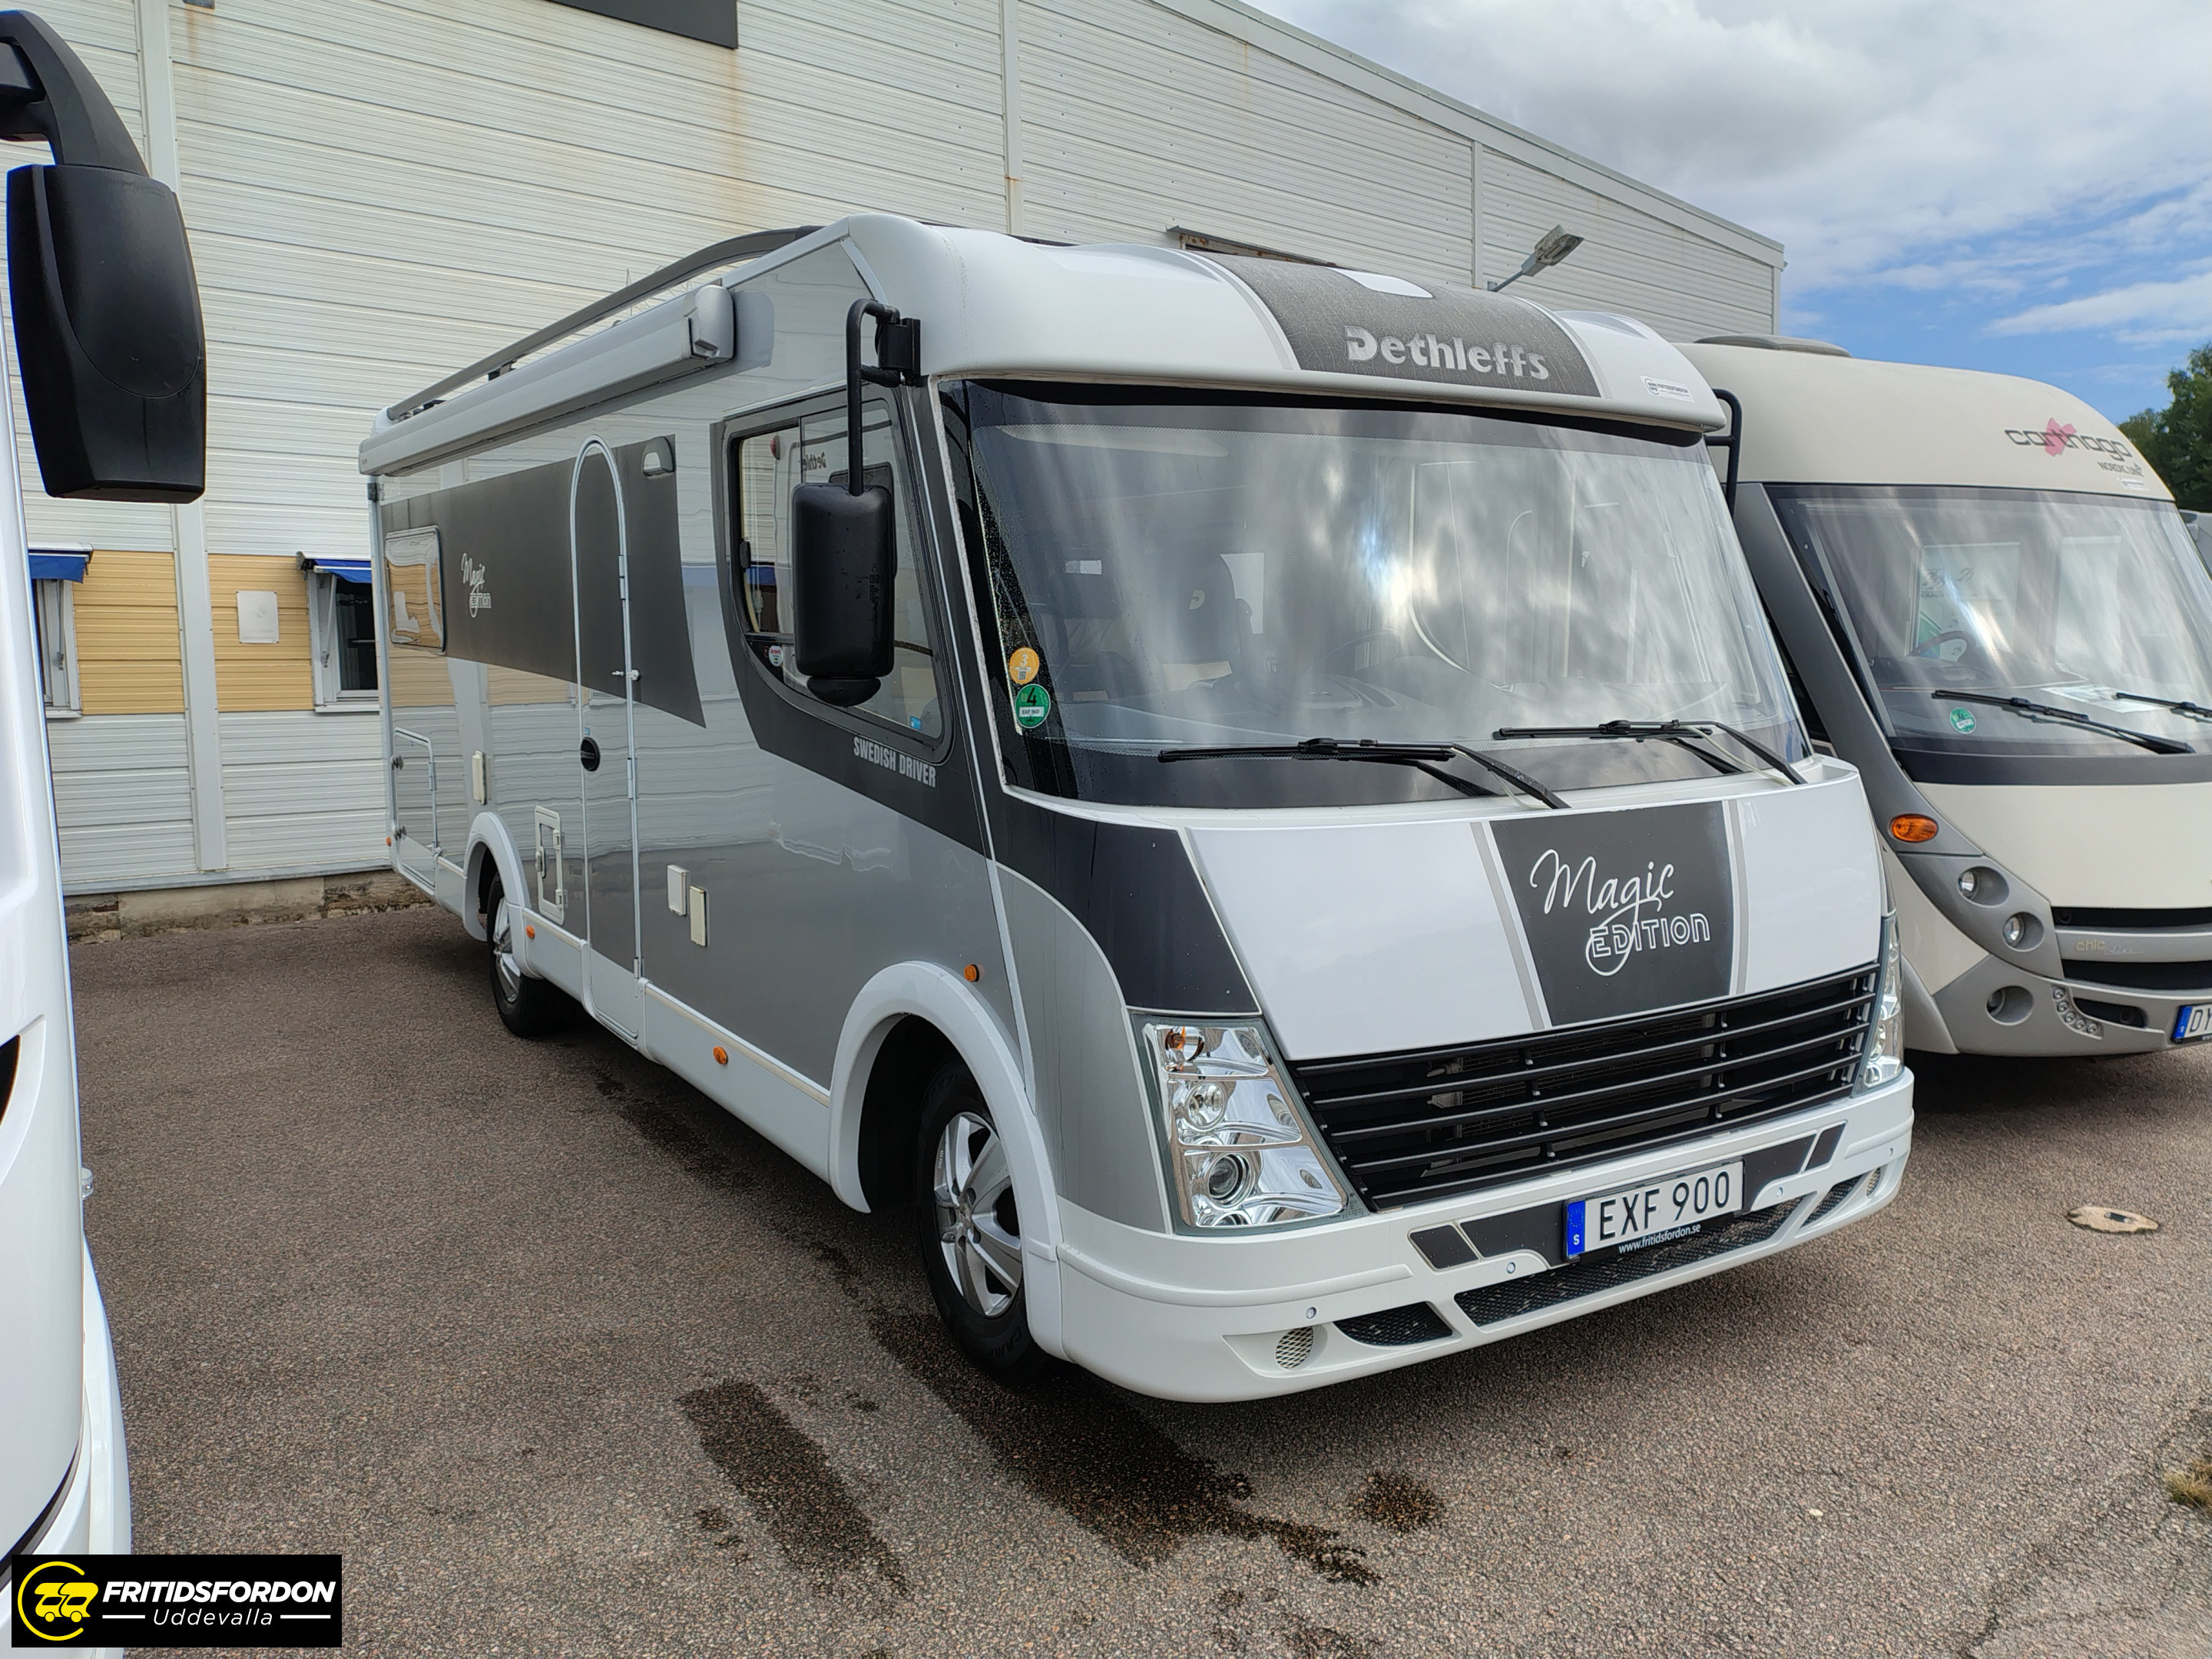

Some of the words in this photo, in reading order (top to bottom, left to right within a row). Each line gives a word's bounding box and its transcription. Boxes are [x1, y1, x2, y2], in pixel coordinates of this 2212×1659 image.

[1344, 325, 1551, 380] Dethleffs
[2004, 429, 2133, 462] carthago
[2098, 461, 2129, 474] NORDIC
[1019, 654, 1028, 667] 3
[1026, 687, 1037, 706] 4
[853, 736, 896, 771] SWEDISH
[899, 753, 935, 788] DRIVER
[1530, 849, 1674, 976] Magic
[2076, 939, 2105, 951] chic
[1600, 1188, 1660, 1242] EXF
[1673, 1171, 1730, 1222] 900
[1573, 1233, 1580, 1246] S
[1618, 1223, 1701, 1254] www.fritidsfordon.se
